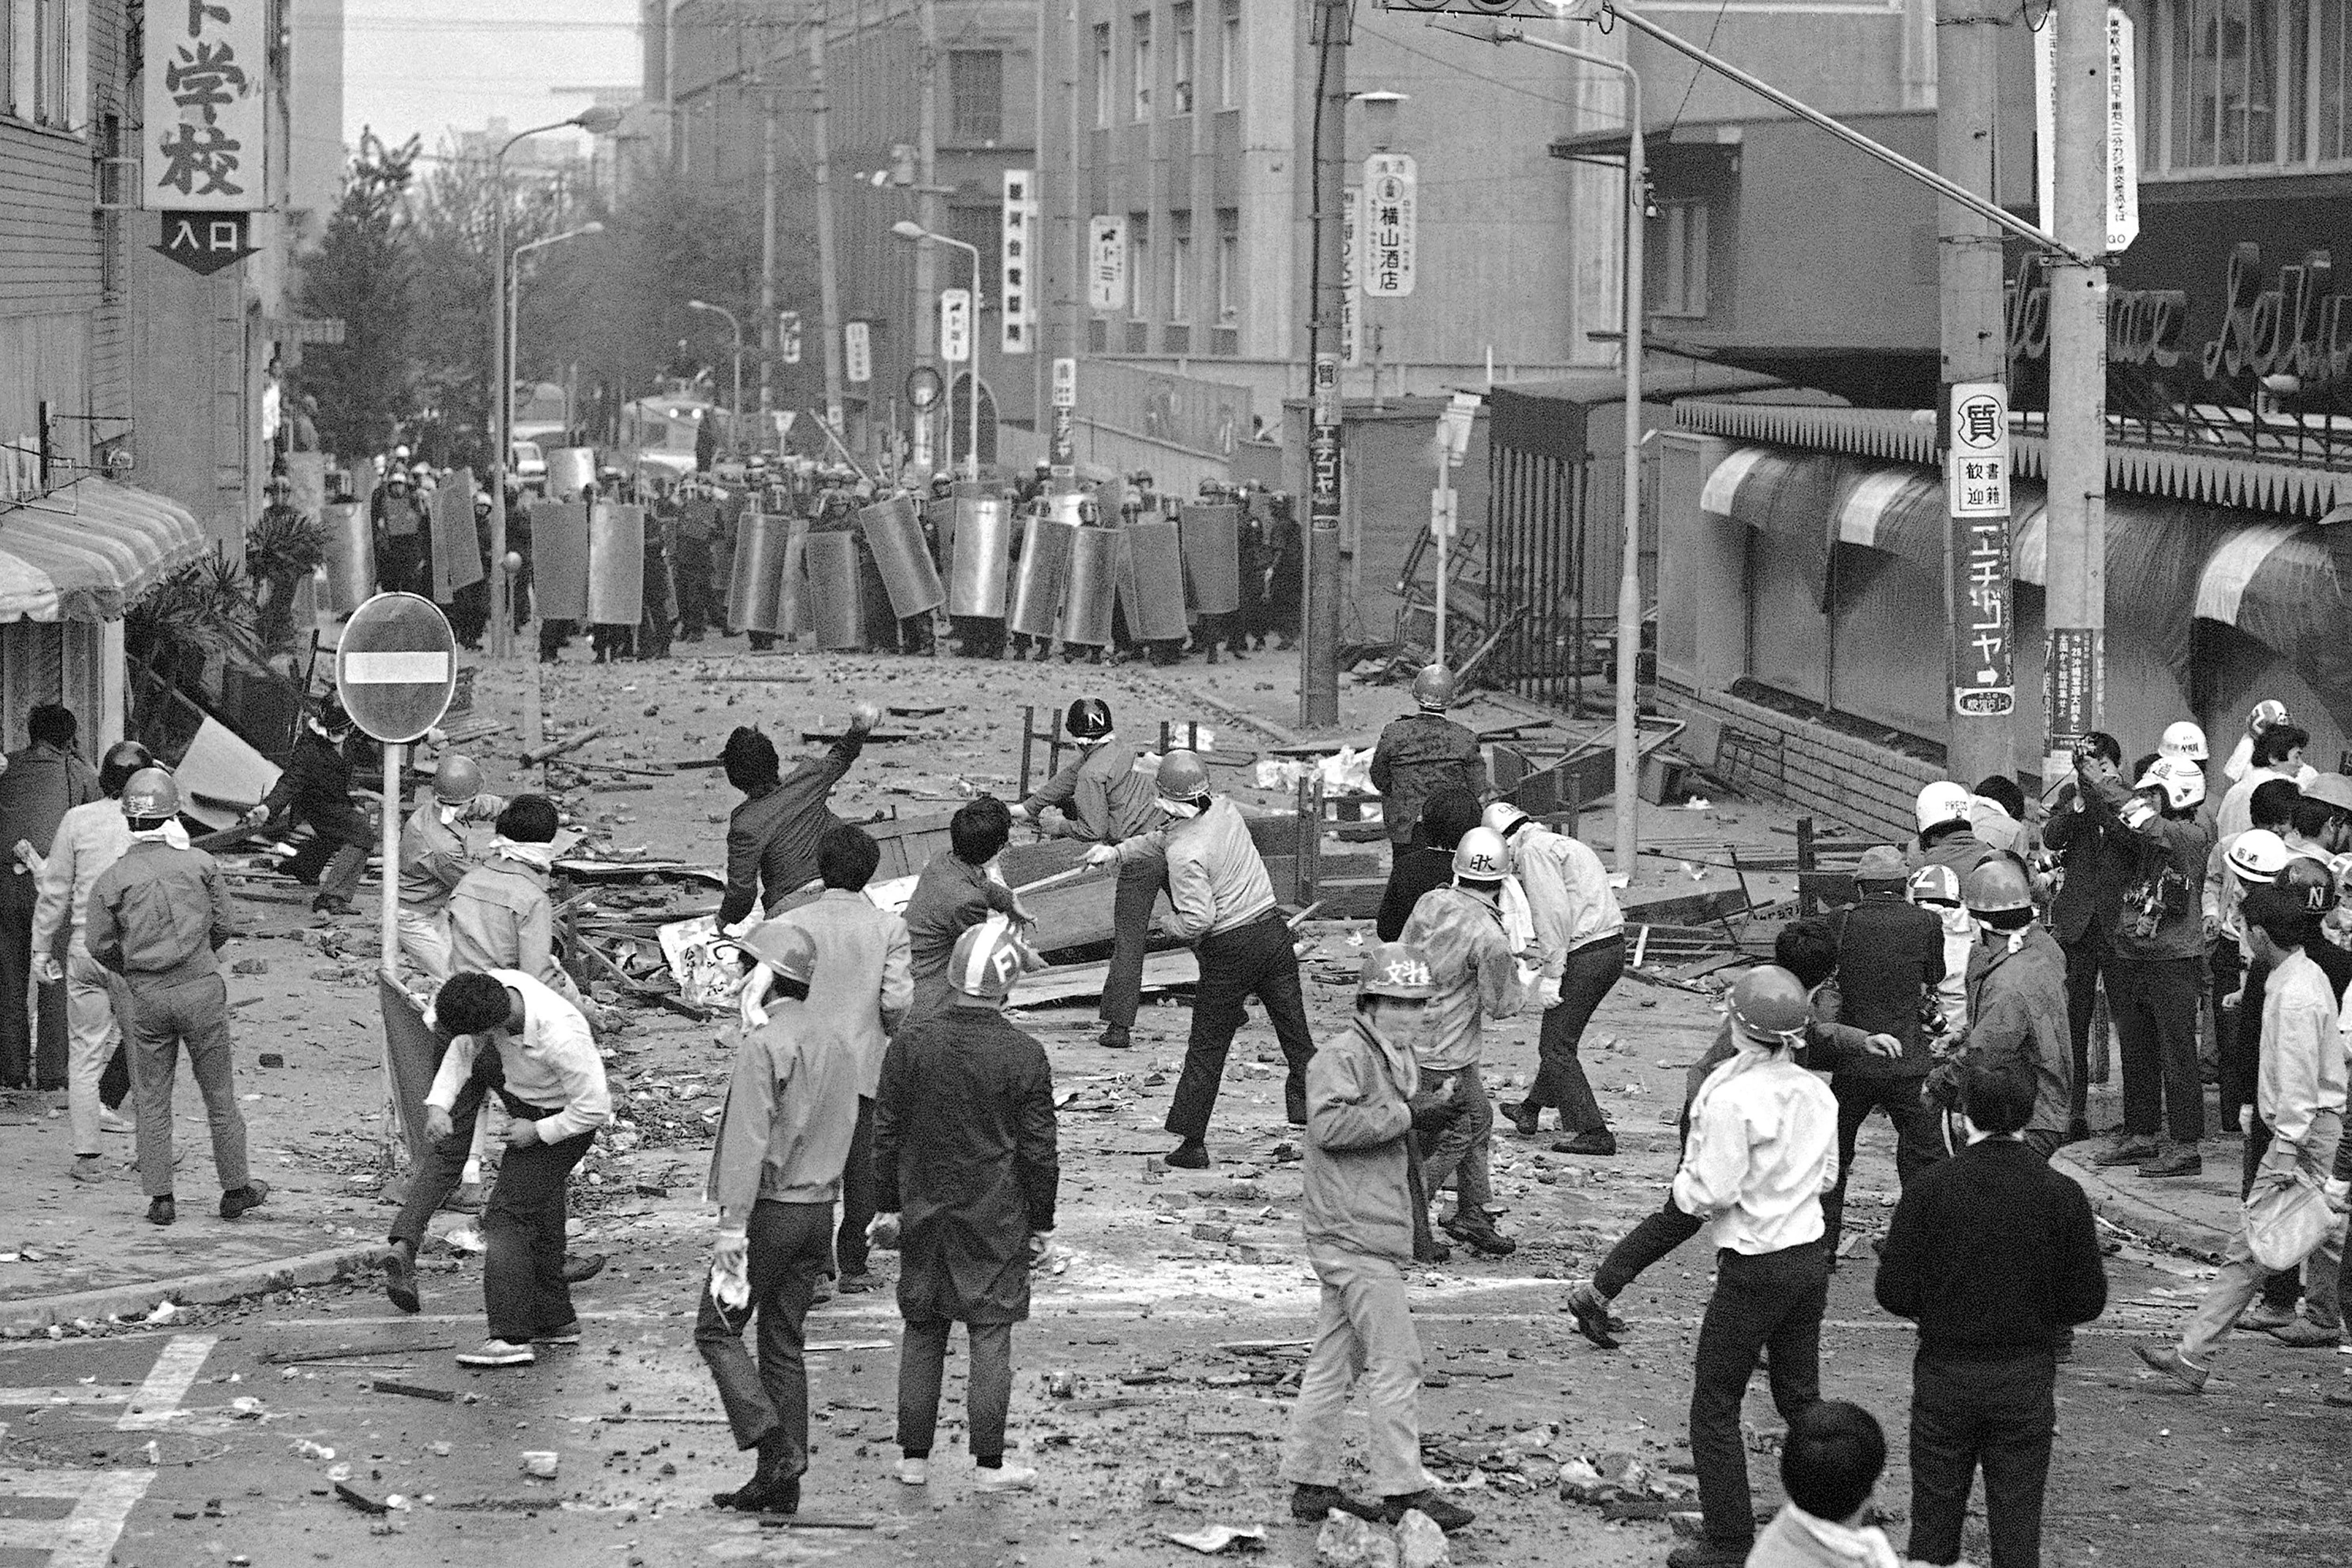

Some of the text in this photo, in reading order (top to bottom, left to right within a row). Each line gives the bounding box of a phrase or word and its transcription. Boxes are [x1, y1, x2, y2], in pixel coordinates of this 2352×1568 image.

[170, 221, 238, 252] 入口
[1380, 206, 1398, 290] 横山酒店
[1968, 404, 1996, 442] 質
[1088, 710, 1104, 729] N
[1945, 801, 1967, 811] PRESS
[2308, 886, 2324, 908] N
